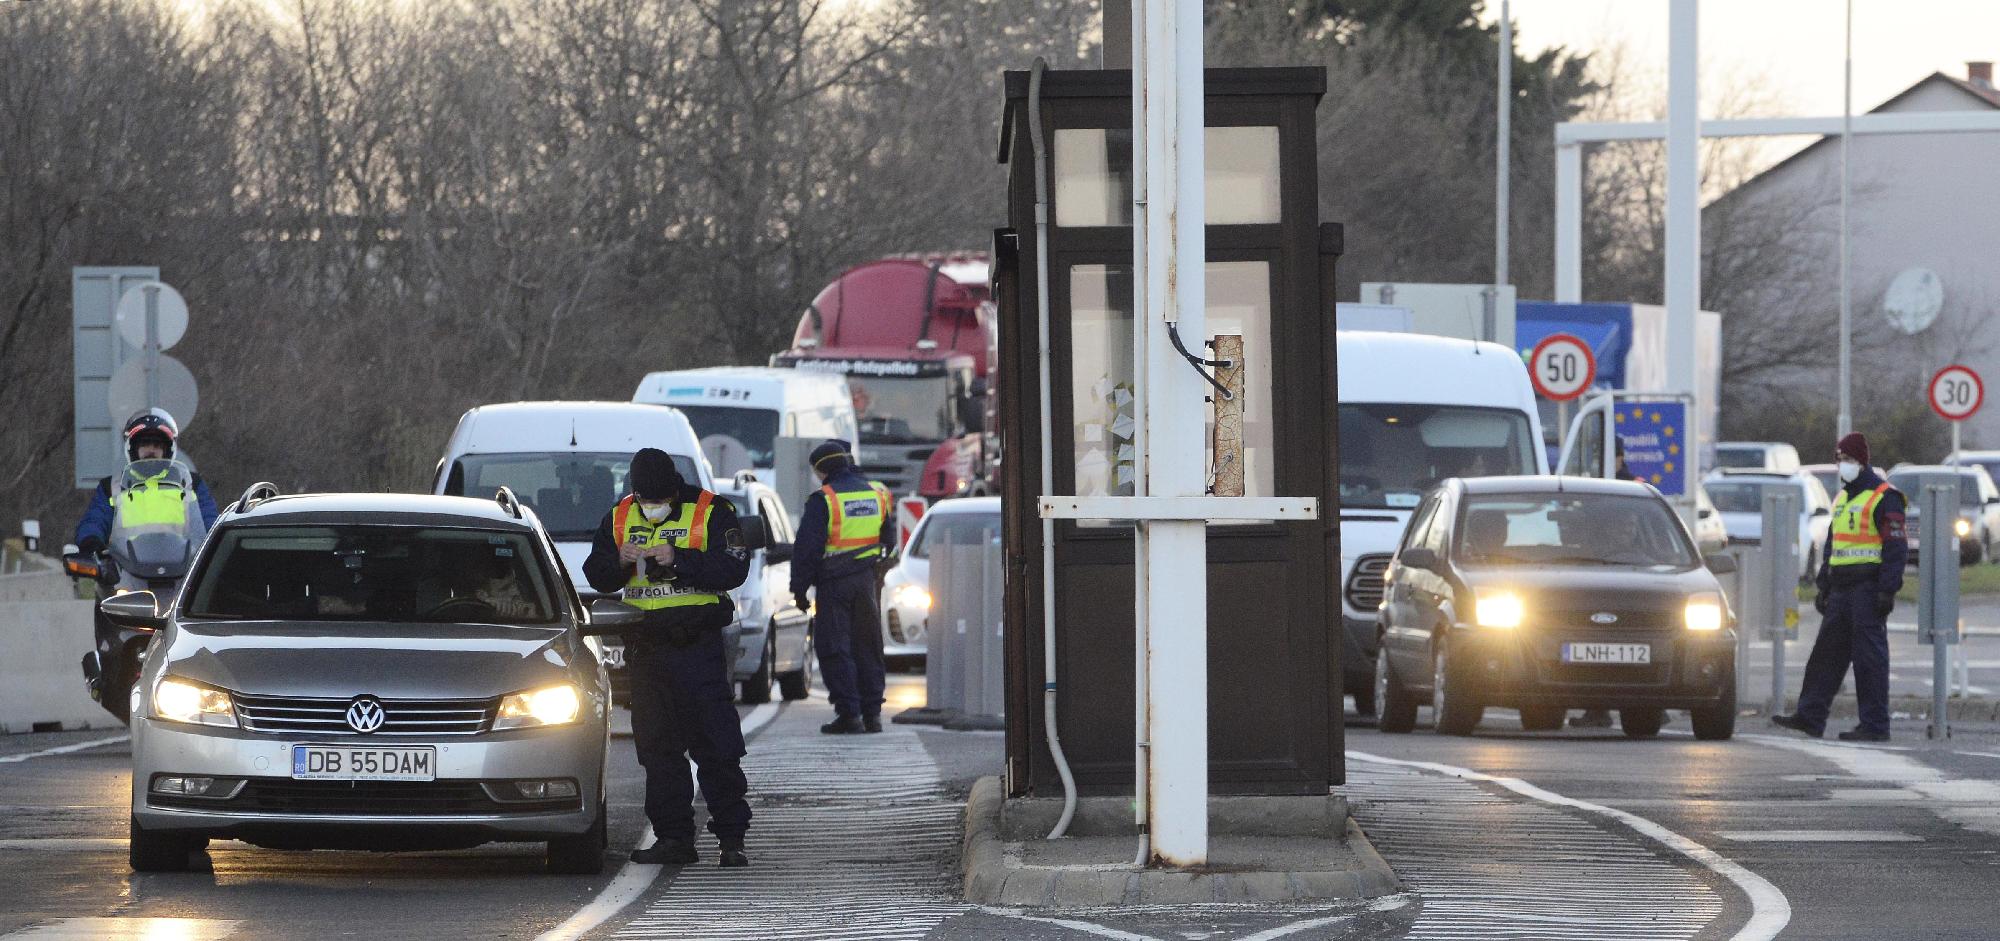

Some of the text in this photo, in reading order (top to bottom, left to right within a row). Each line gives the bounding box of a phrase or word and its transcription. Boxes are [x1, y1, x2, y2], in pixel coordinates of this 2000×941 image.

[1547, 353, 1576, 382] 50
[1942, 379, 1970, 406] 30
[1617, 432, 1659, 449] epublik
[660, 529, 688, 538] POLICE
[1573, 645, 1647, 661] LNH-112
[308, 751, 342, 773] DB
[351, 751, 378, 774] 55
[382, 751, 429, 775] DAM
